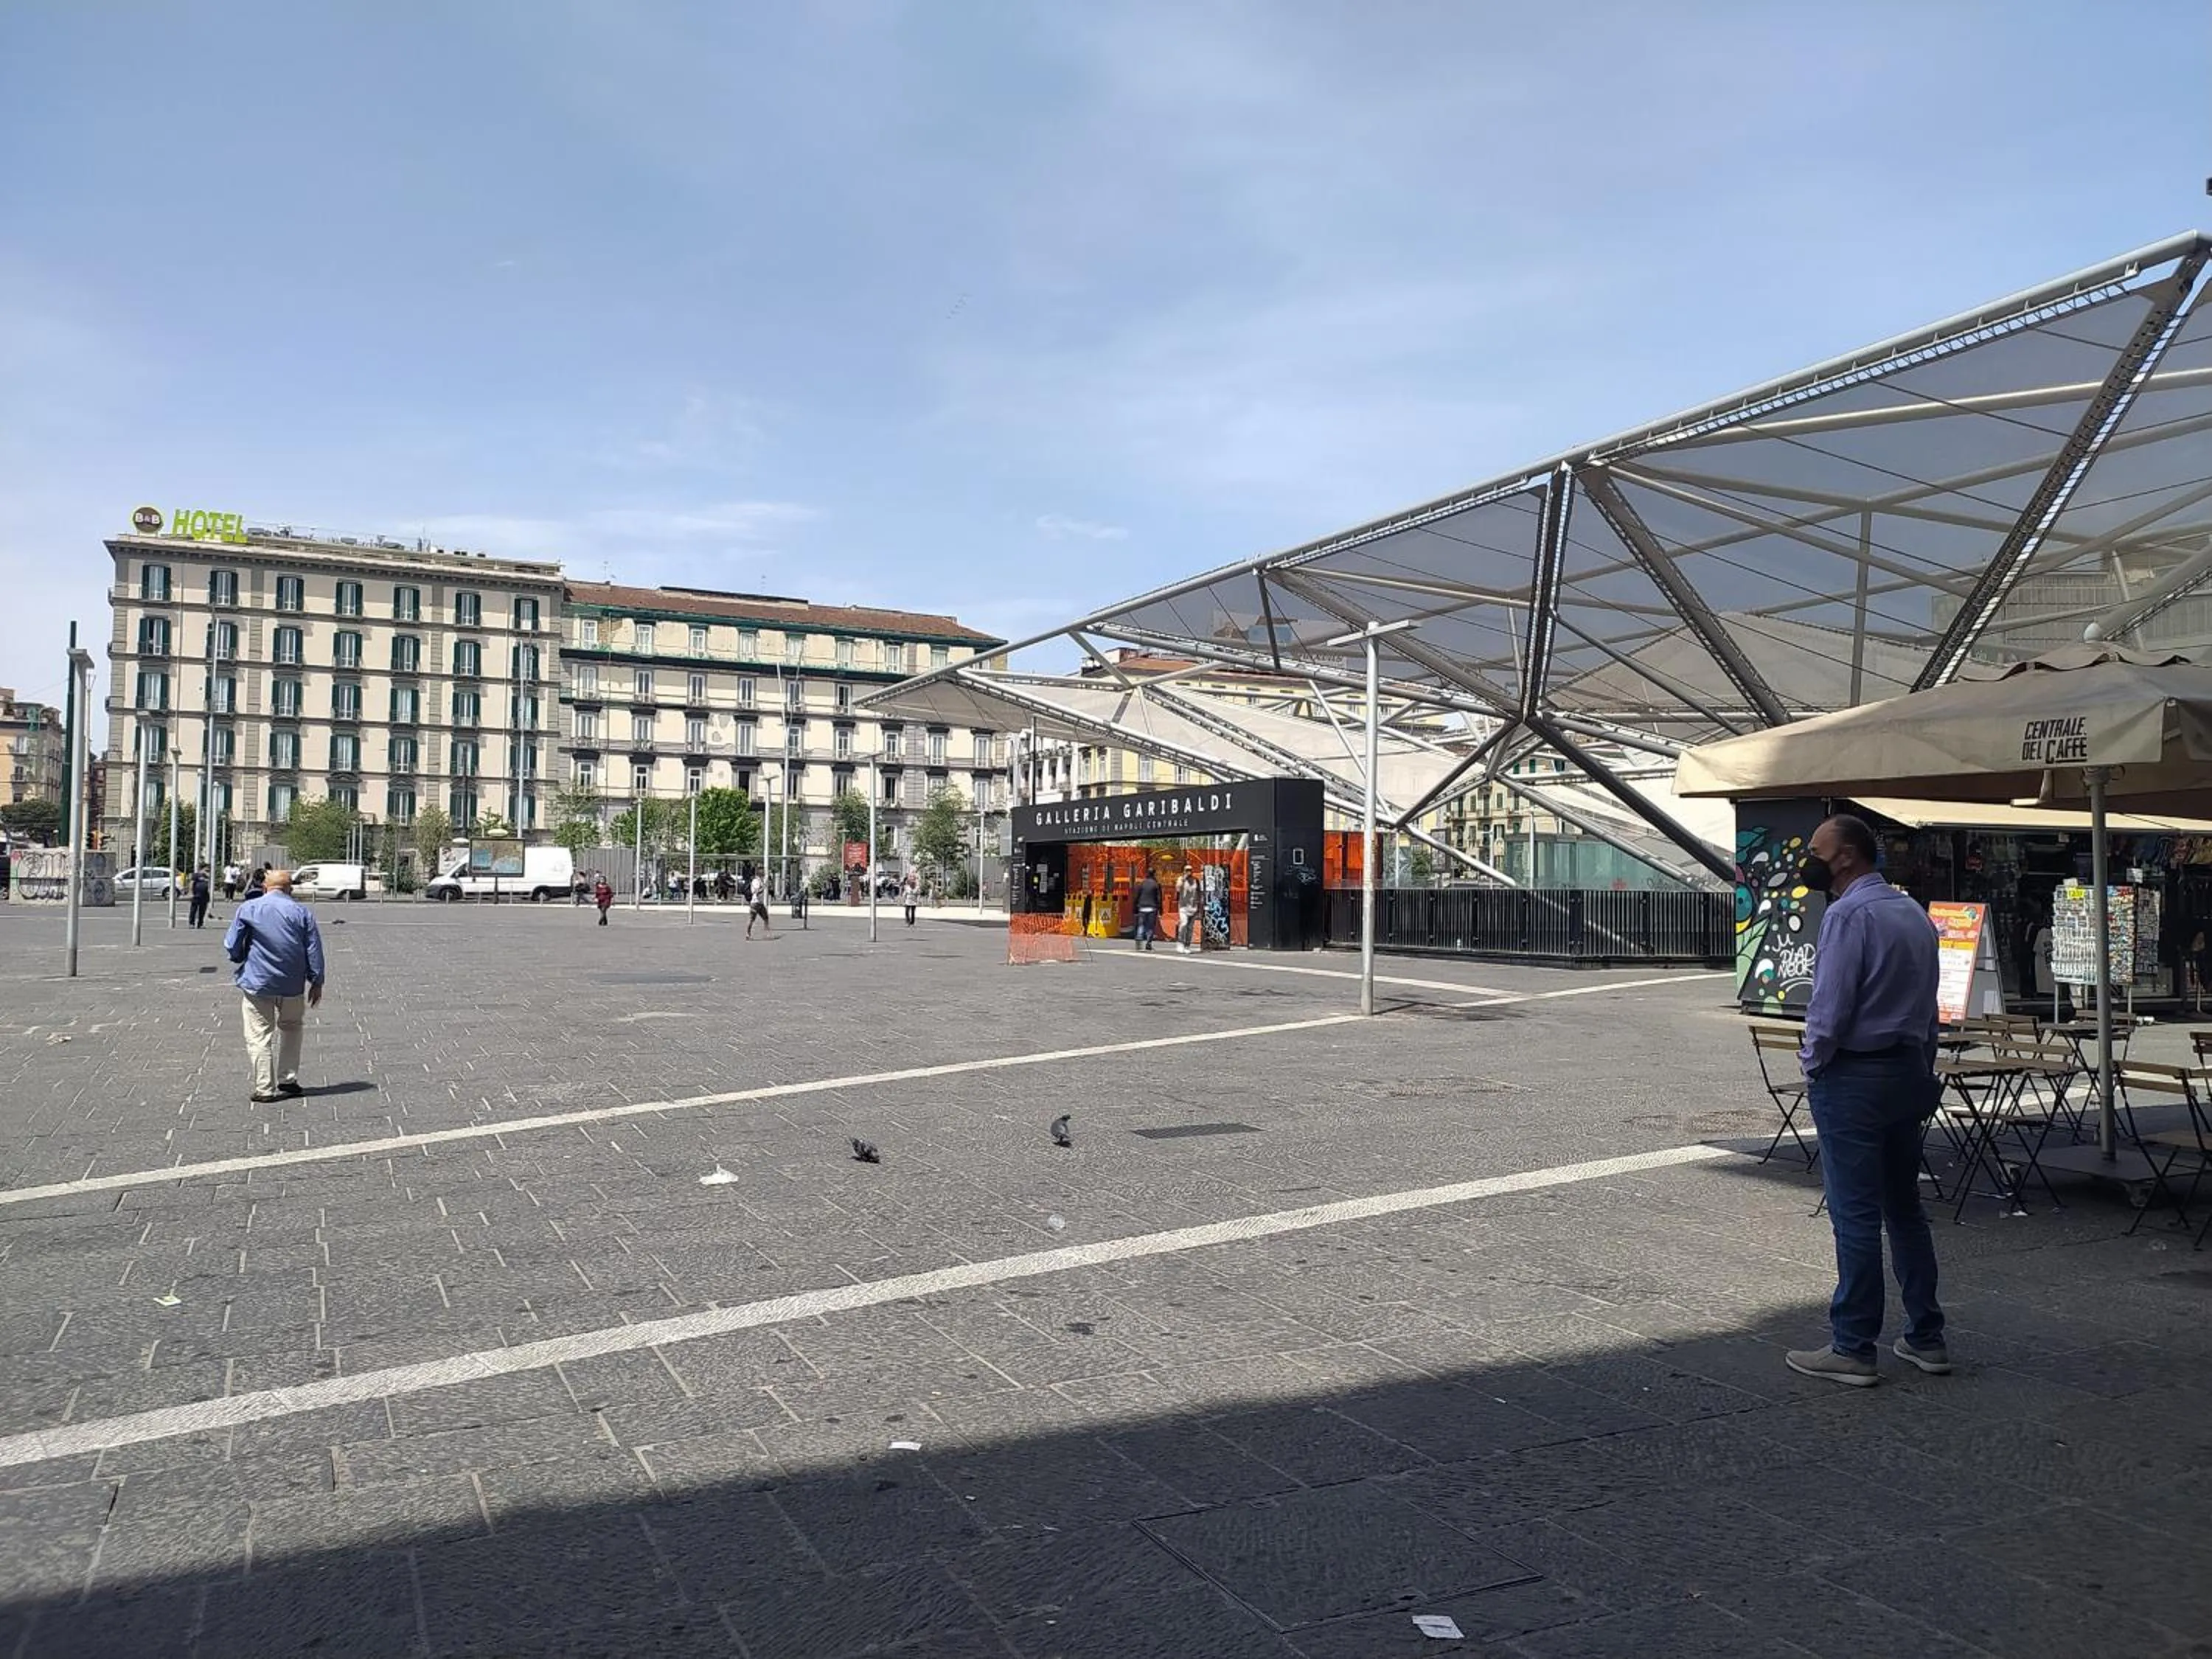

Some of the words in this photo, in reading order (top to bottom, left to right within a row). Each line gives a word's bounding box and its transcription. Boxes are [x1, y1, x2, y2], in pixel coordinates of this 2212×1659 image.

[135, 512, 161, 524] B&B
[172, 509, 248, 543] HOTEL
[2024, 717, 2087, 740] CENTRALE
[2022, 741, 2042, 760] DEL
[1035, 805, 1110, 826] GALLERIA
[1123, 793, 1232, 818] GARIBALDI
[1114, 821, 1143, 831] NAPOLI
[1147, 818, 1189, 830] CENTRALE
